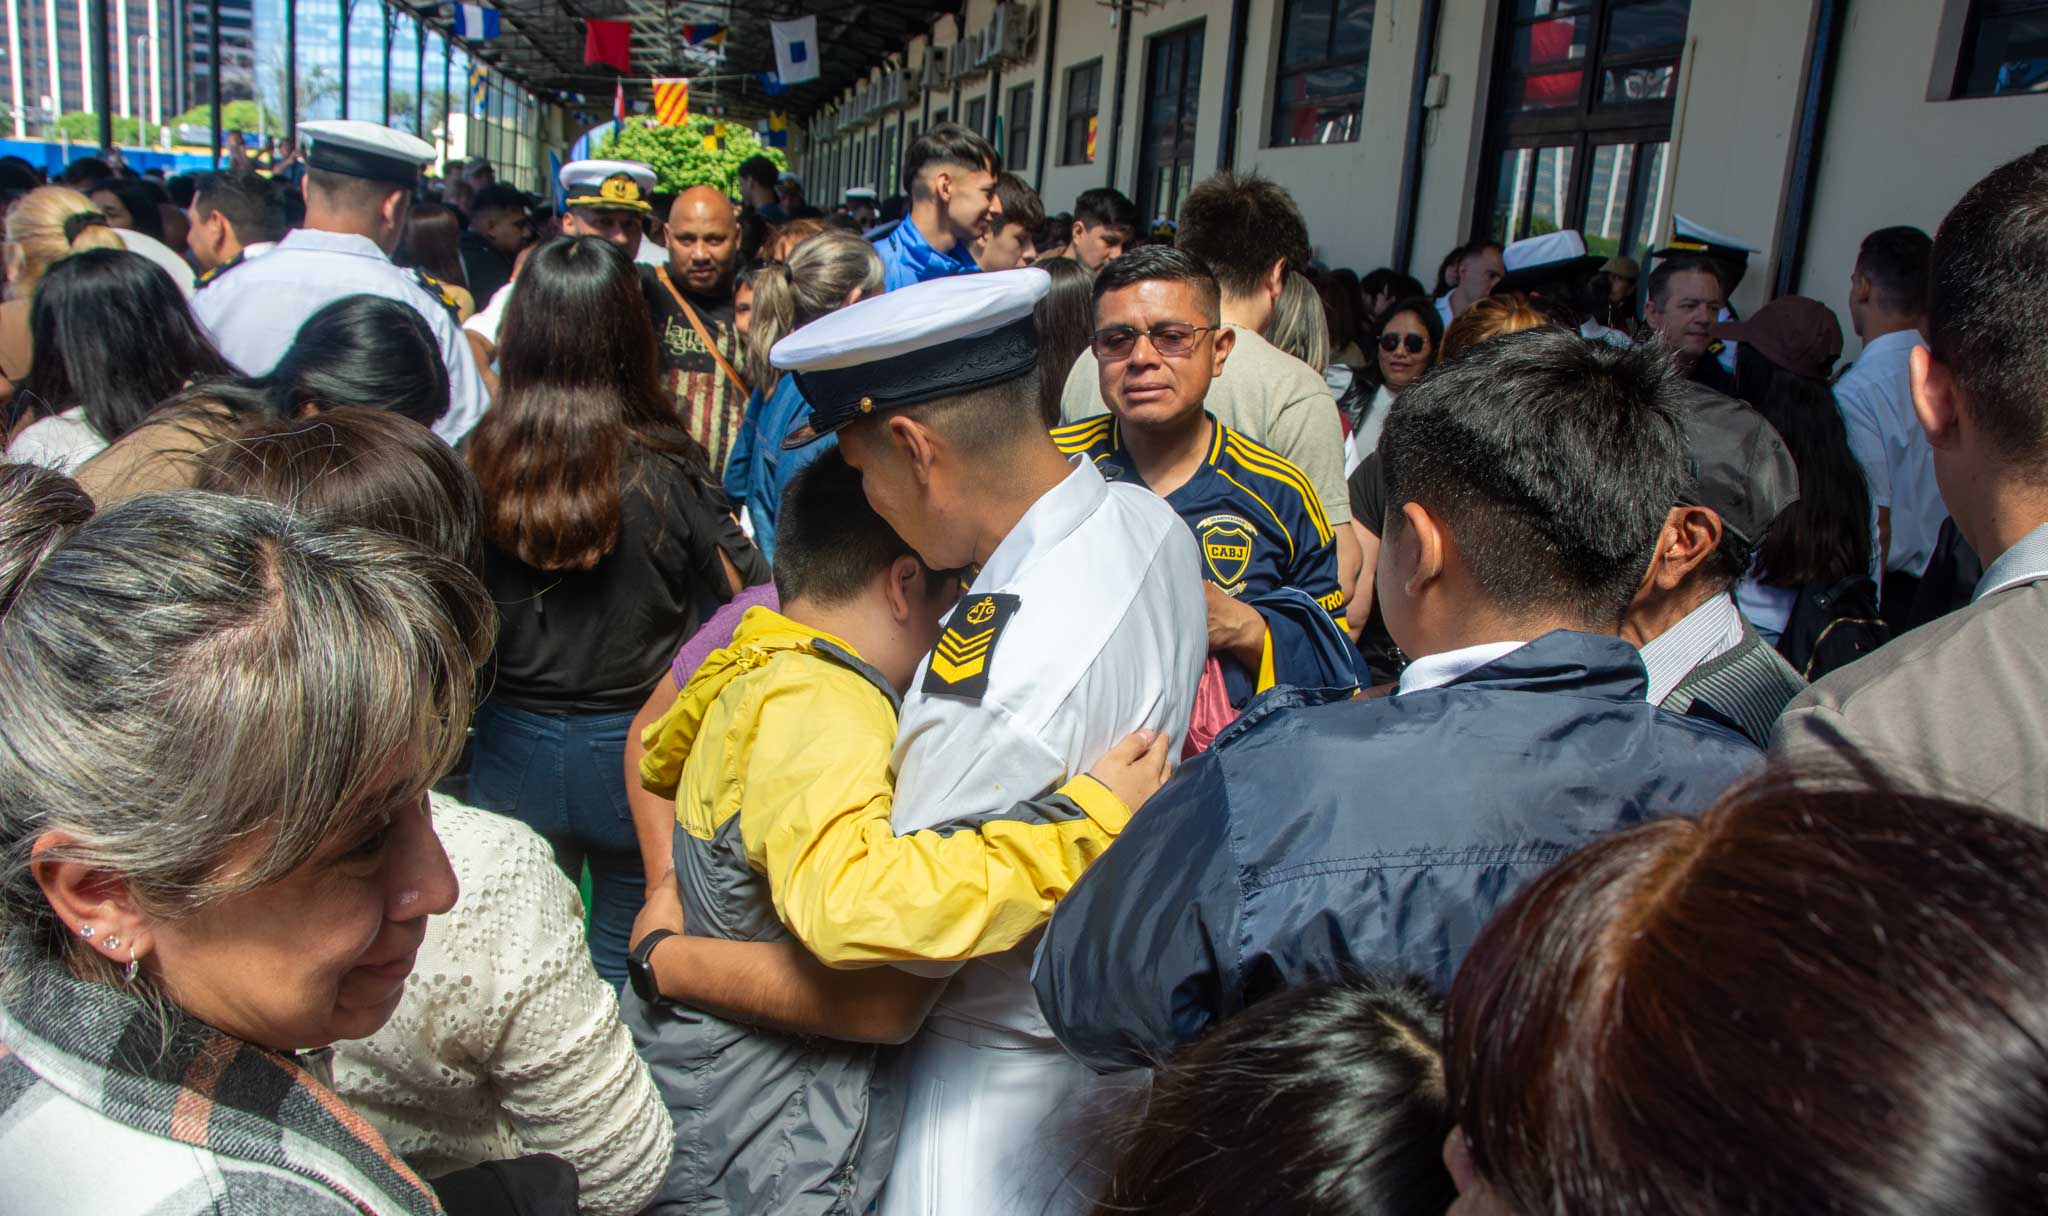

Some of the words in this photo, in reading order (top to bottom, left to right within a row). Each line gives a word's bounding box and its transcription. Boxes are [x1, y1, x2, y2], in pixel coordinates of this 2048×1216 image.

[664, 315, 702, 342] lam
[1211, 546, 1244, 559] CABJ
[1315, 590, 1345, 611] TRO
